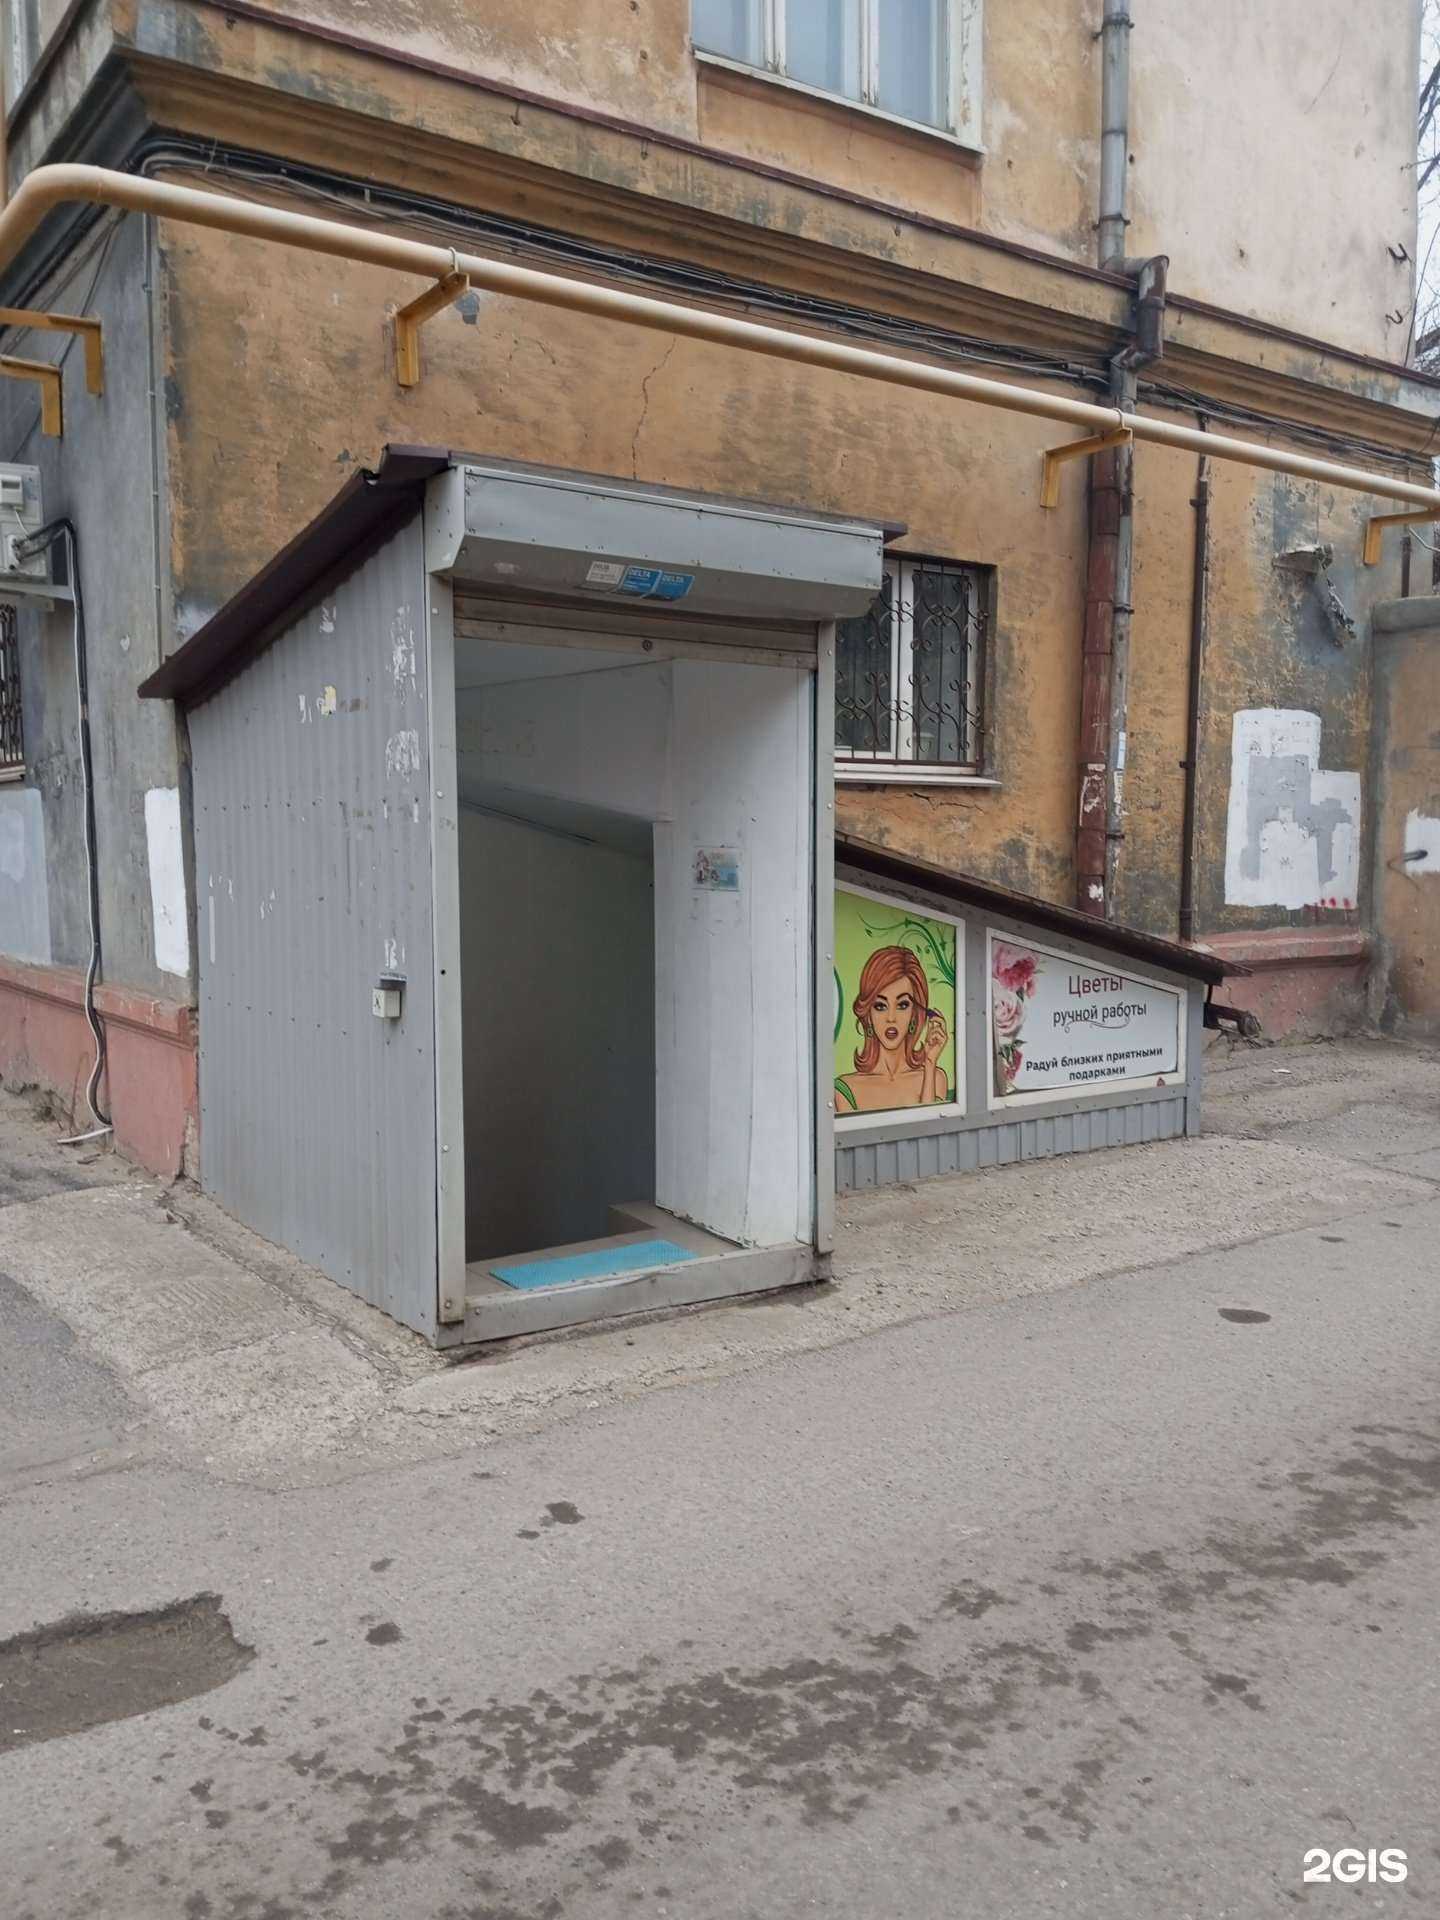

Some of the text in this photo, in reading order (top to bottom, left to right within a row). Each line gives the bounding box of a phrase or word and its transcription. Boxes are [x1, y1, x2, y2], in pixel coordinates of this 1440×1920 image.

[1068, 975, 1123, 997] Цветы
[1053, 1003, 1146, 1027] ручной работы
[1026, 1047, 1162, 1071] Радуй близких приятными
[1069, 1067, 1125, 1080] подарками
